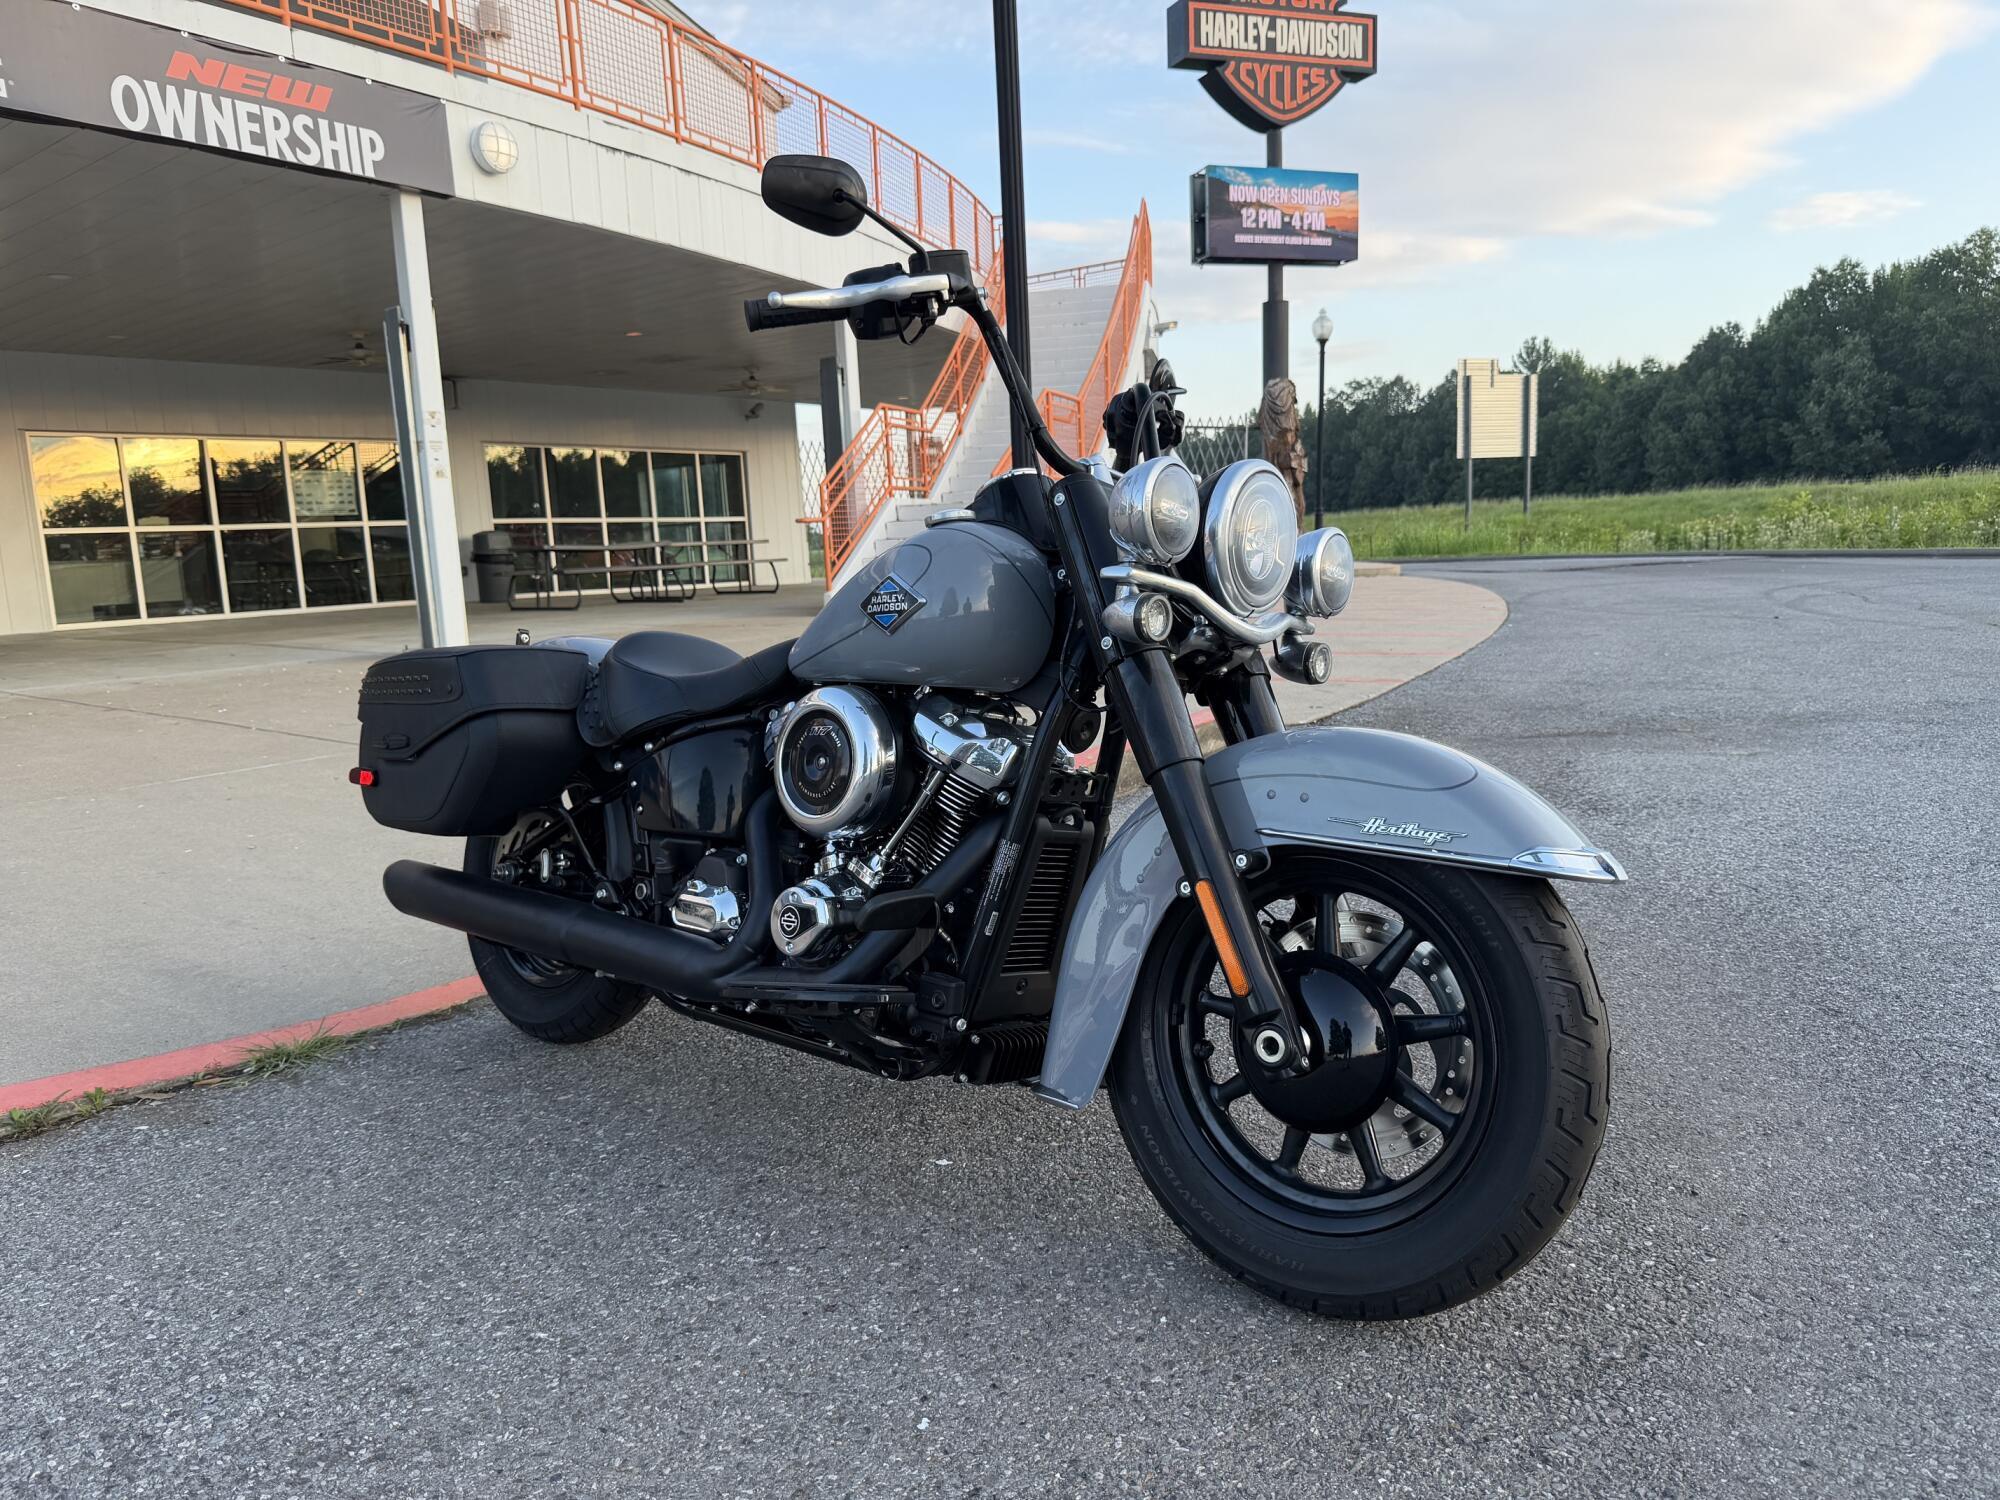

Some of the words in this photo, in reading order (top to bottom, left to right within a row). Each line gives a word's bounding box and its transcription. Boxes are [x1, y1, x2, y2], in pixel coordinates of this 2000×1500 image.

[1200, 10, 1363, 60] HARLEY-DAVIDSON
[165, 50, 334, 113] NEW
[1239, 62, 1328, 110] CYCLES
[110, 74, 385, 178] OWNERSHIP
[1228, 184, 1257, 203] NOW
[1259, 186, 1288, 205] OPEN
[1290, 187, 1340, 207] SUNDAYS
[1240, 207, 1256, 229] 12
[1258, 208, 1282, 230] PM
[1291, 210, 1301, 231] 4
[1303, 211, 1326, 232] PM
[867, 602, 908, 613] DAVIDSON
[1360, 816, 1455, 846] Heritage
